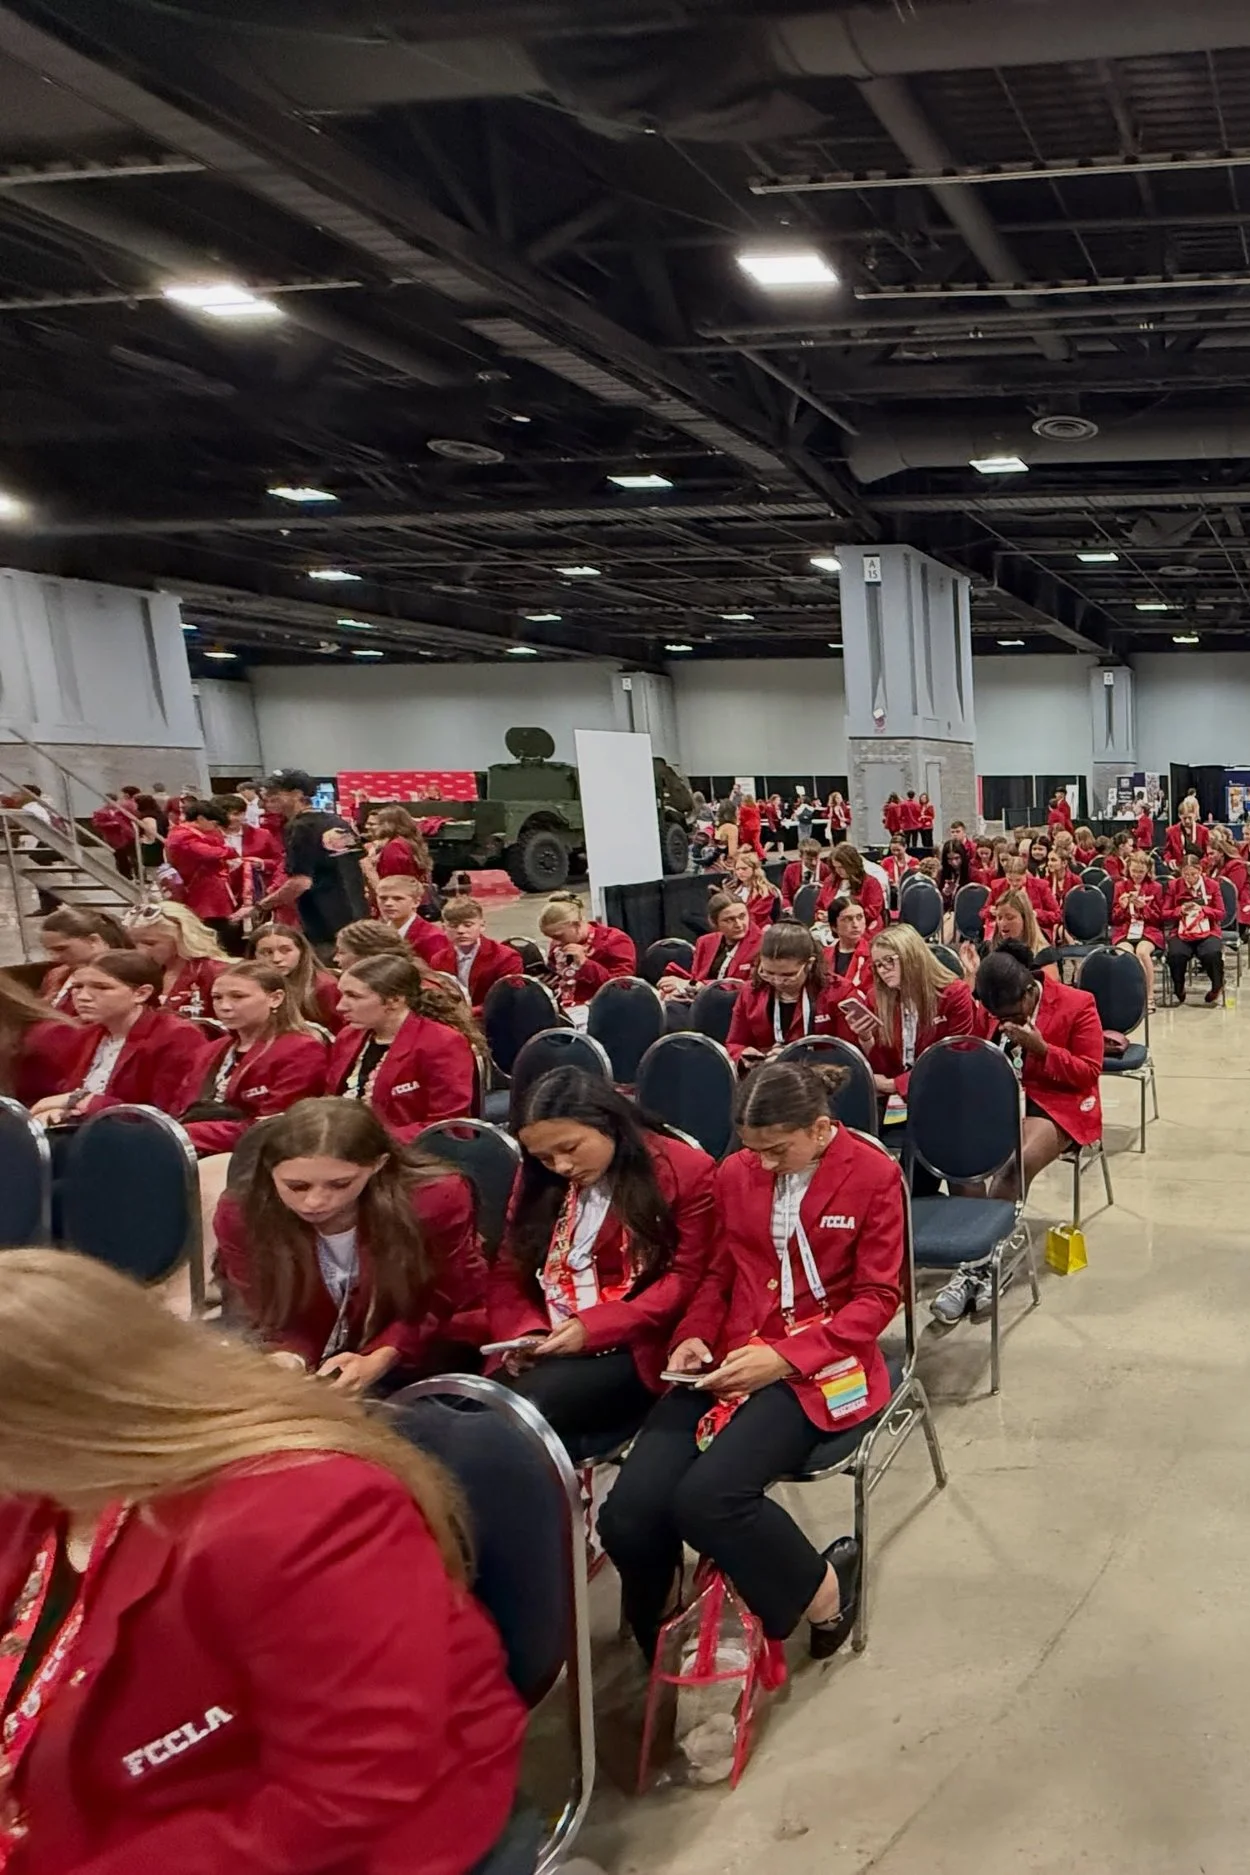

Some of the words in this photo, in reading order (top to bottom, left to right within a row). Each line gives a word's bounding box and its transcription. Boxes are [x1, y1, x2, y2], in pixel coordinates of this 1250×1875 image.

[869, 559, 876, 569] A
[868, 570, 878, 579] 15
[819, 1215, 855, 1230] FCCLA
[122, 1706, 234, 1776] FCCLA
